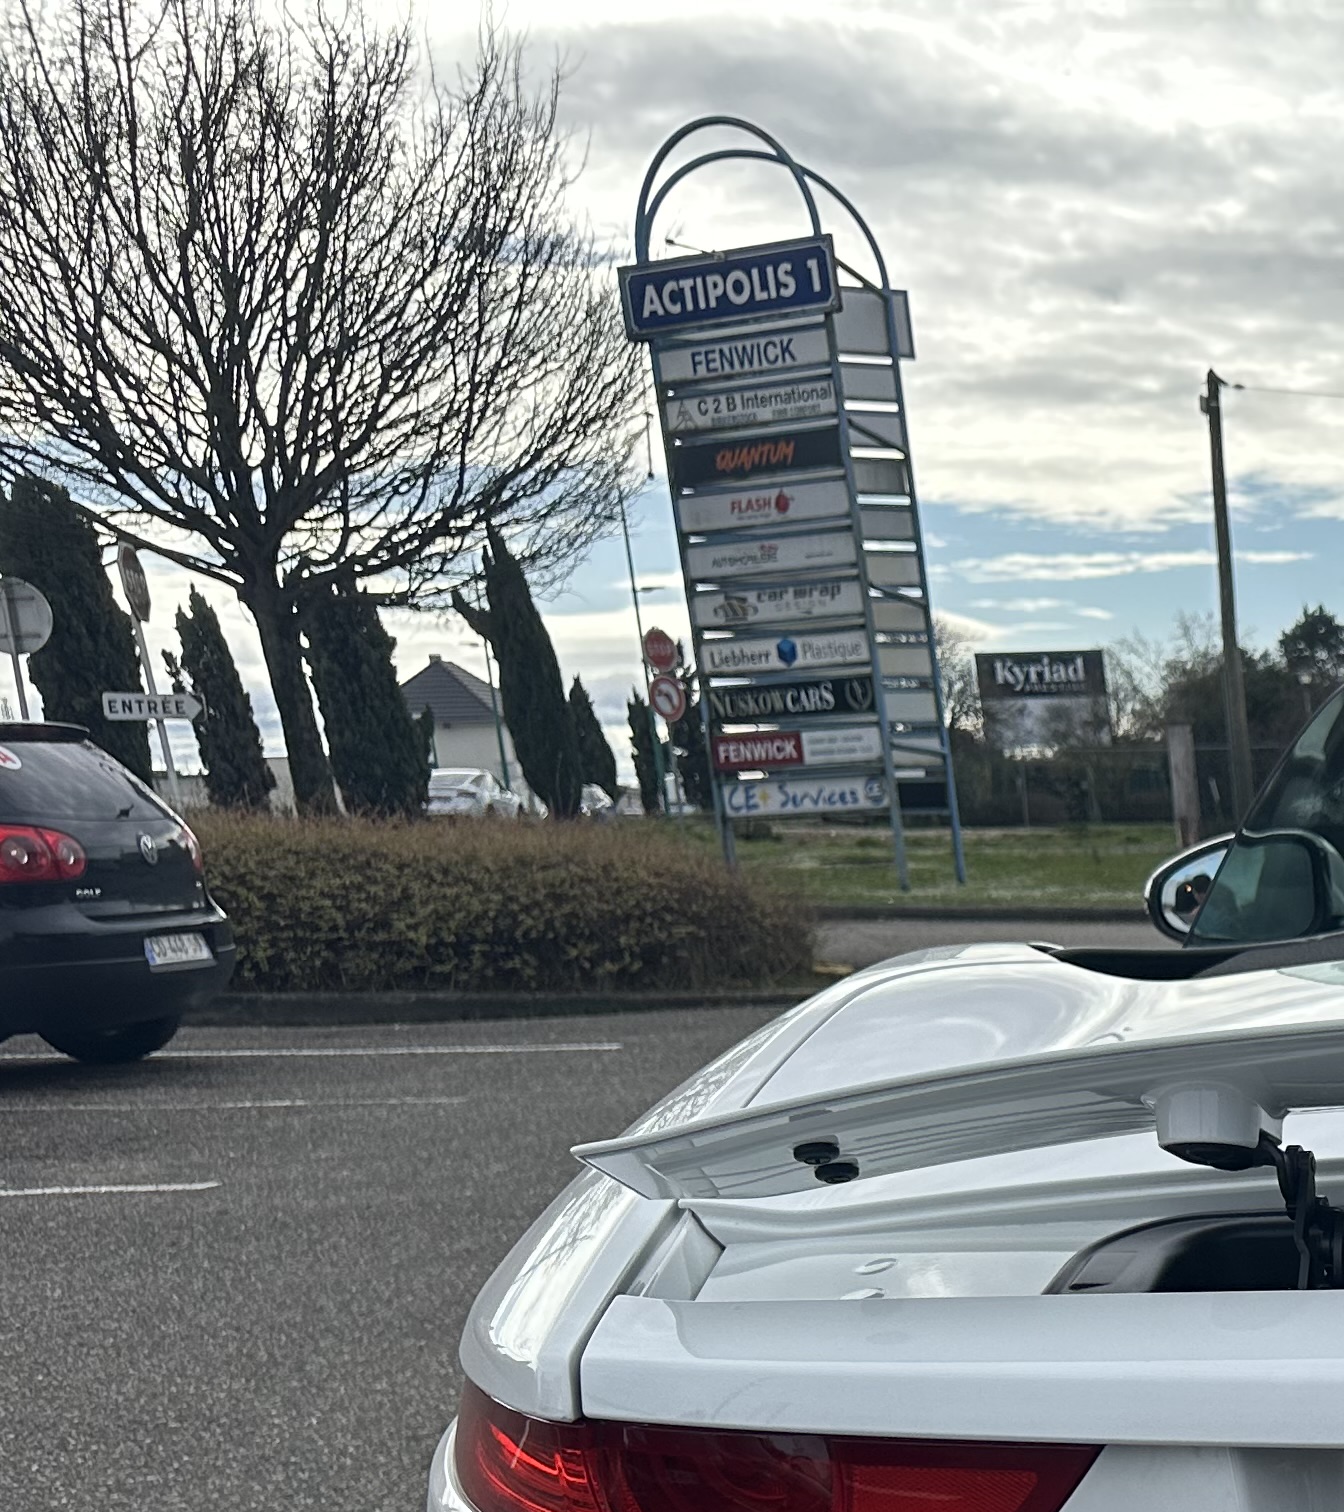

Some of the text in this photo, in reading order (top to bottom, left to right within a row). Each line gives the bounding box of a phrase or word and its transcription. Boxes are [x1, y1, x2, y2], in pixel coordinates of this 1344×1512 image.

[642, 257, 823, 318] ACTIPOLIS 1
[690, 338, 797, 376] FENWICK
[697, 383, 833, 417] C 2 B International
[716, 440, 796, 472] QUANTUM
[730, 496, 772, 515] FLASH
[710, 638, 864, 669] Liebherr Plastique
[993, 655, 1086, 692] Kyriad
[108, 696, 187, 715] ENTRÉE
[718, 738, 799, 764] FENWICK
[779, 784, 860, 809] Services
